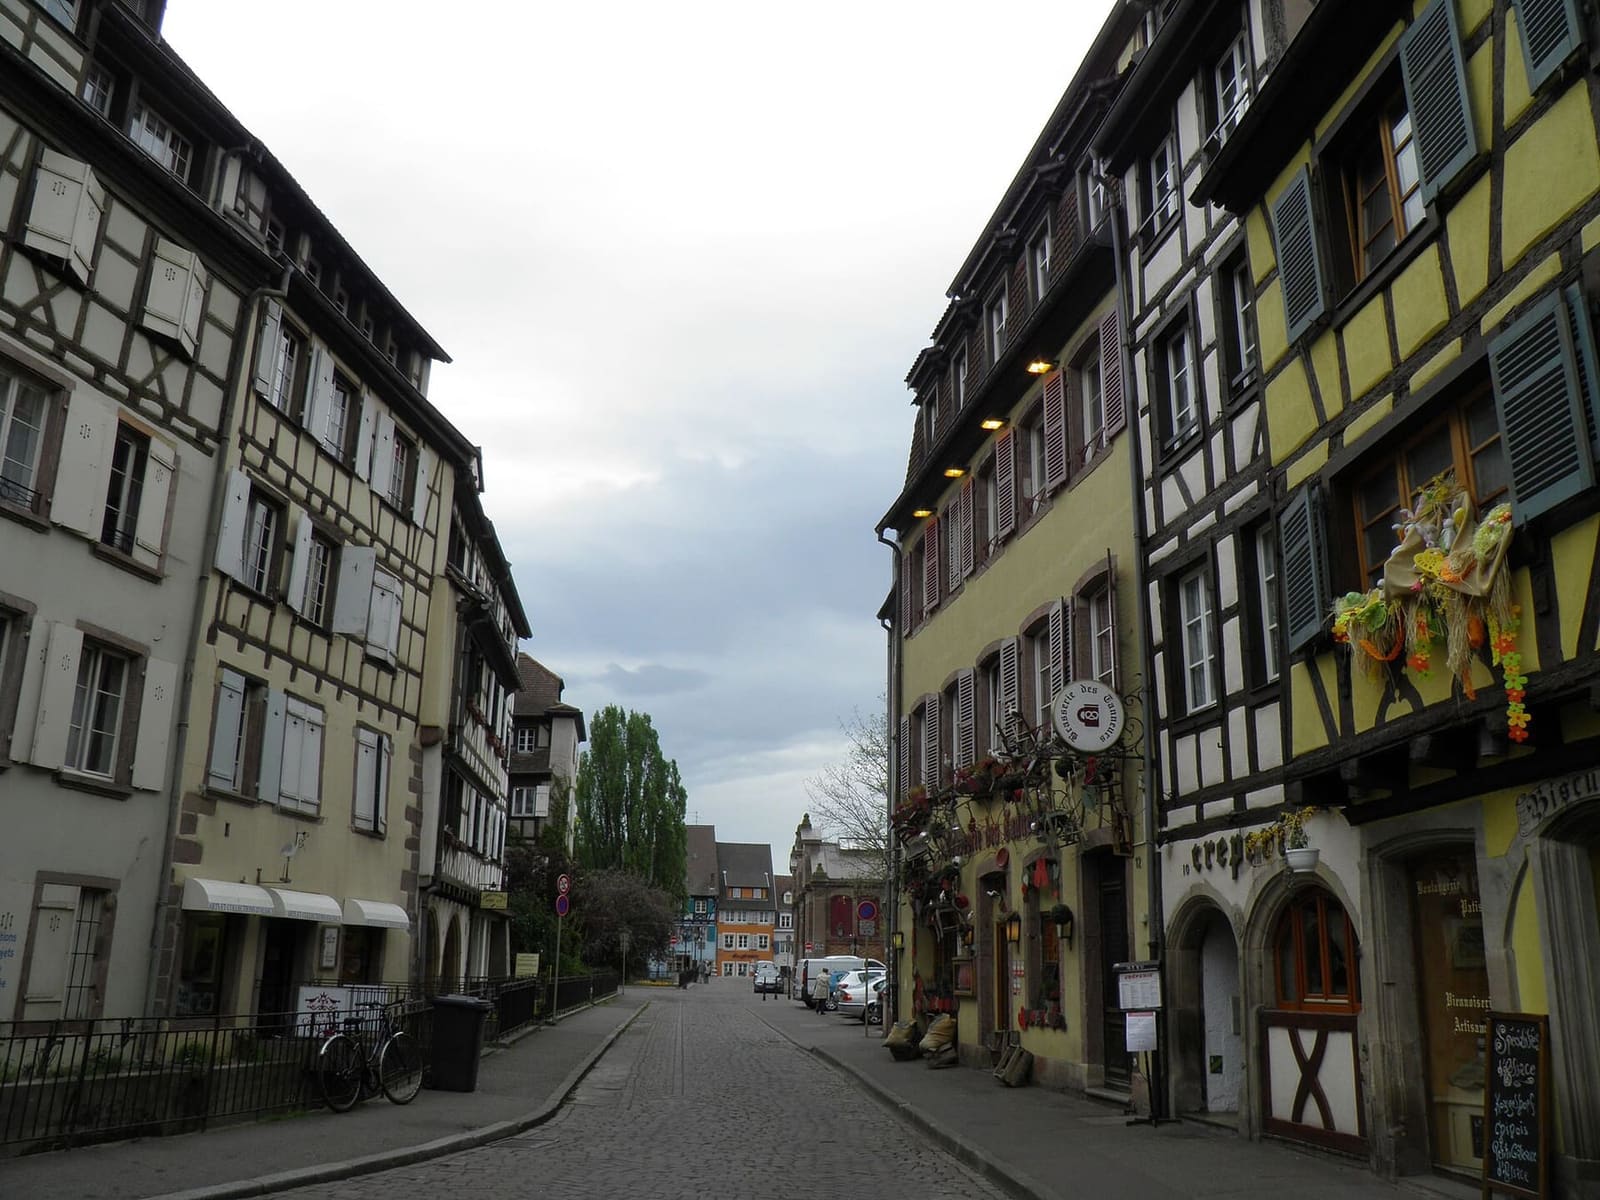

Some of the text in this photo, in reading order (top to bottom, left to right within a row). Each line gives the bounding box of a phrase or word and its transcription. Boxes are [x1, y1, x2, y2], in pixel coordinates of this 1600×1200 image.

[1061, 684, 1118, 743] Brasserie des Tanneurs
[1135, 855, 1142, 870] 12
[1182, 863, 1191, 877] 10
